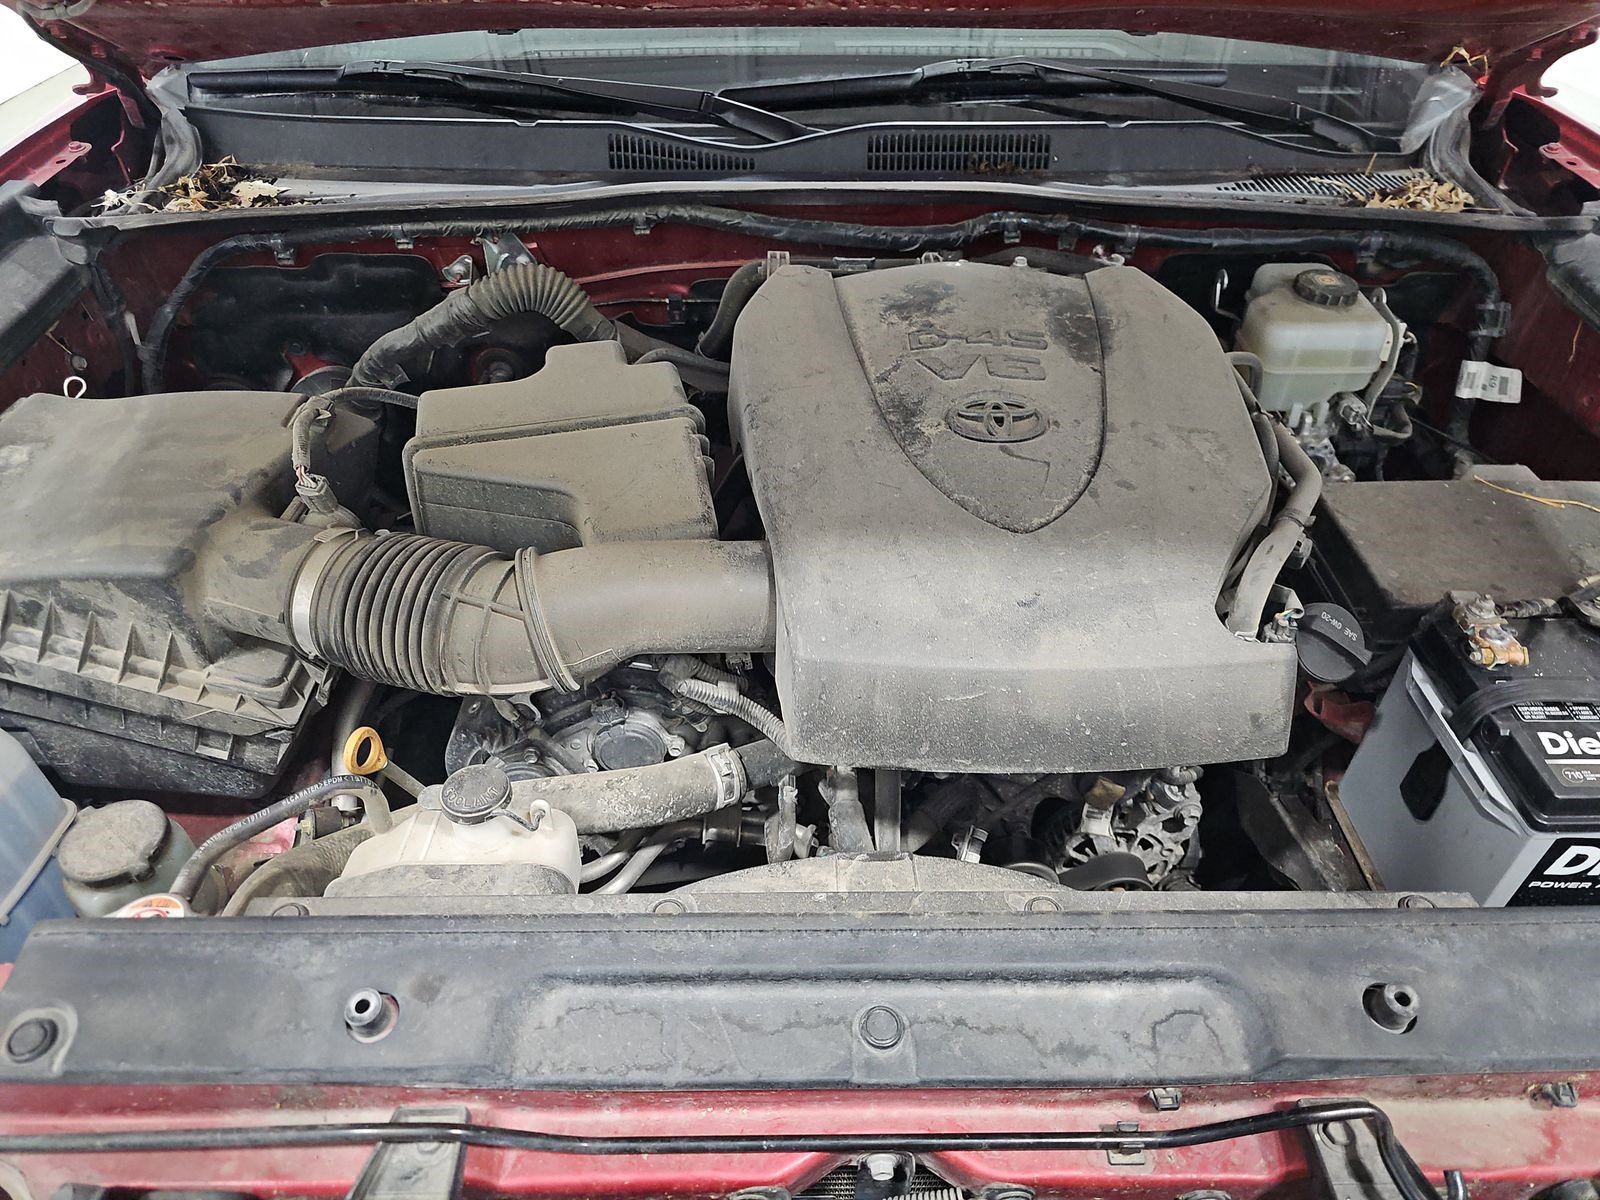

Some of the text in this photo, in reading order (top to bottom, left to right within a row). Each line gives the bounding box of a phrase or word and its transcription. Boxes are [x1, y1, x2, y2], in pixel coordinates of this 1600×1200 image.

[908, 327, 1048, 351] D-4S
[915, 353, 1047, 381] V6
[1321, 611, 1358, 641] SAE 0W-20
[1536, 730, 1600, 755] Die
[1564, 771, 1584, 780] 710
[1528, 881, 1592, 889] POWER
